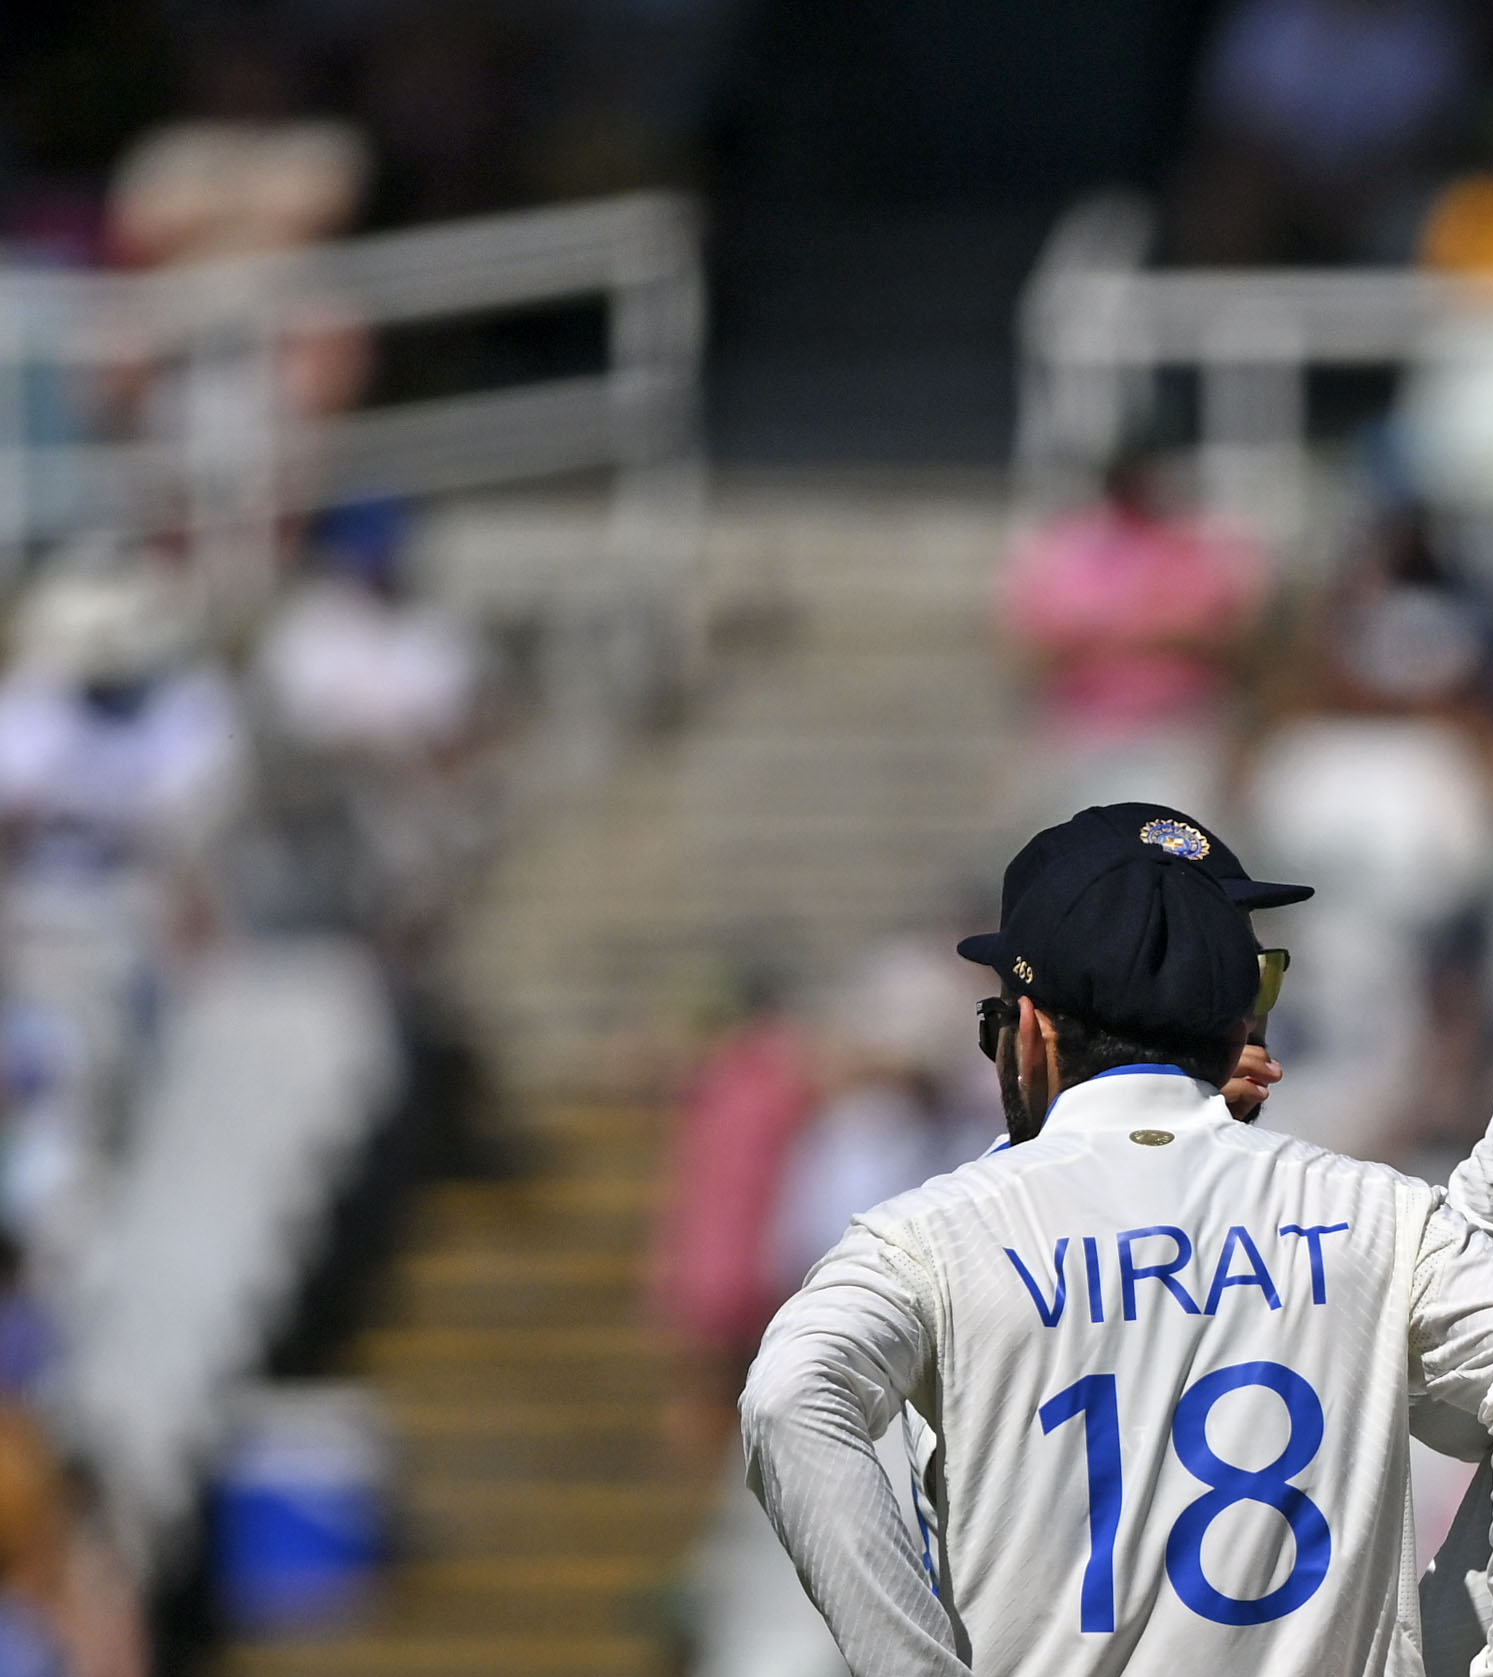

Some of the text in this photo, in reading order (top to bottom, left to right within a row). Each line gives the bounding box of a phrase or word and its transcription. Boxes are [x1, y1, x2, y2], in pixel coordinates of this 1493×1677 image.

[1012, 956, 1033, 984] 269
[1003, 1221, 1351, 1329] VIRAT
[1038, 1360, 1334, 1634] 18
